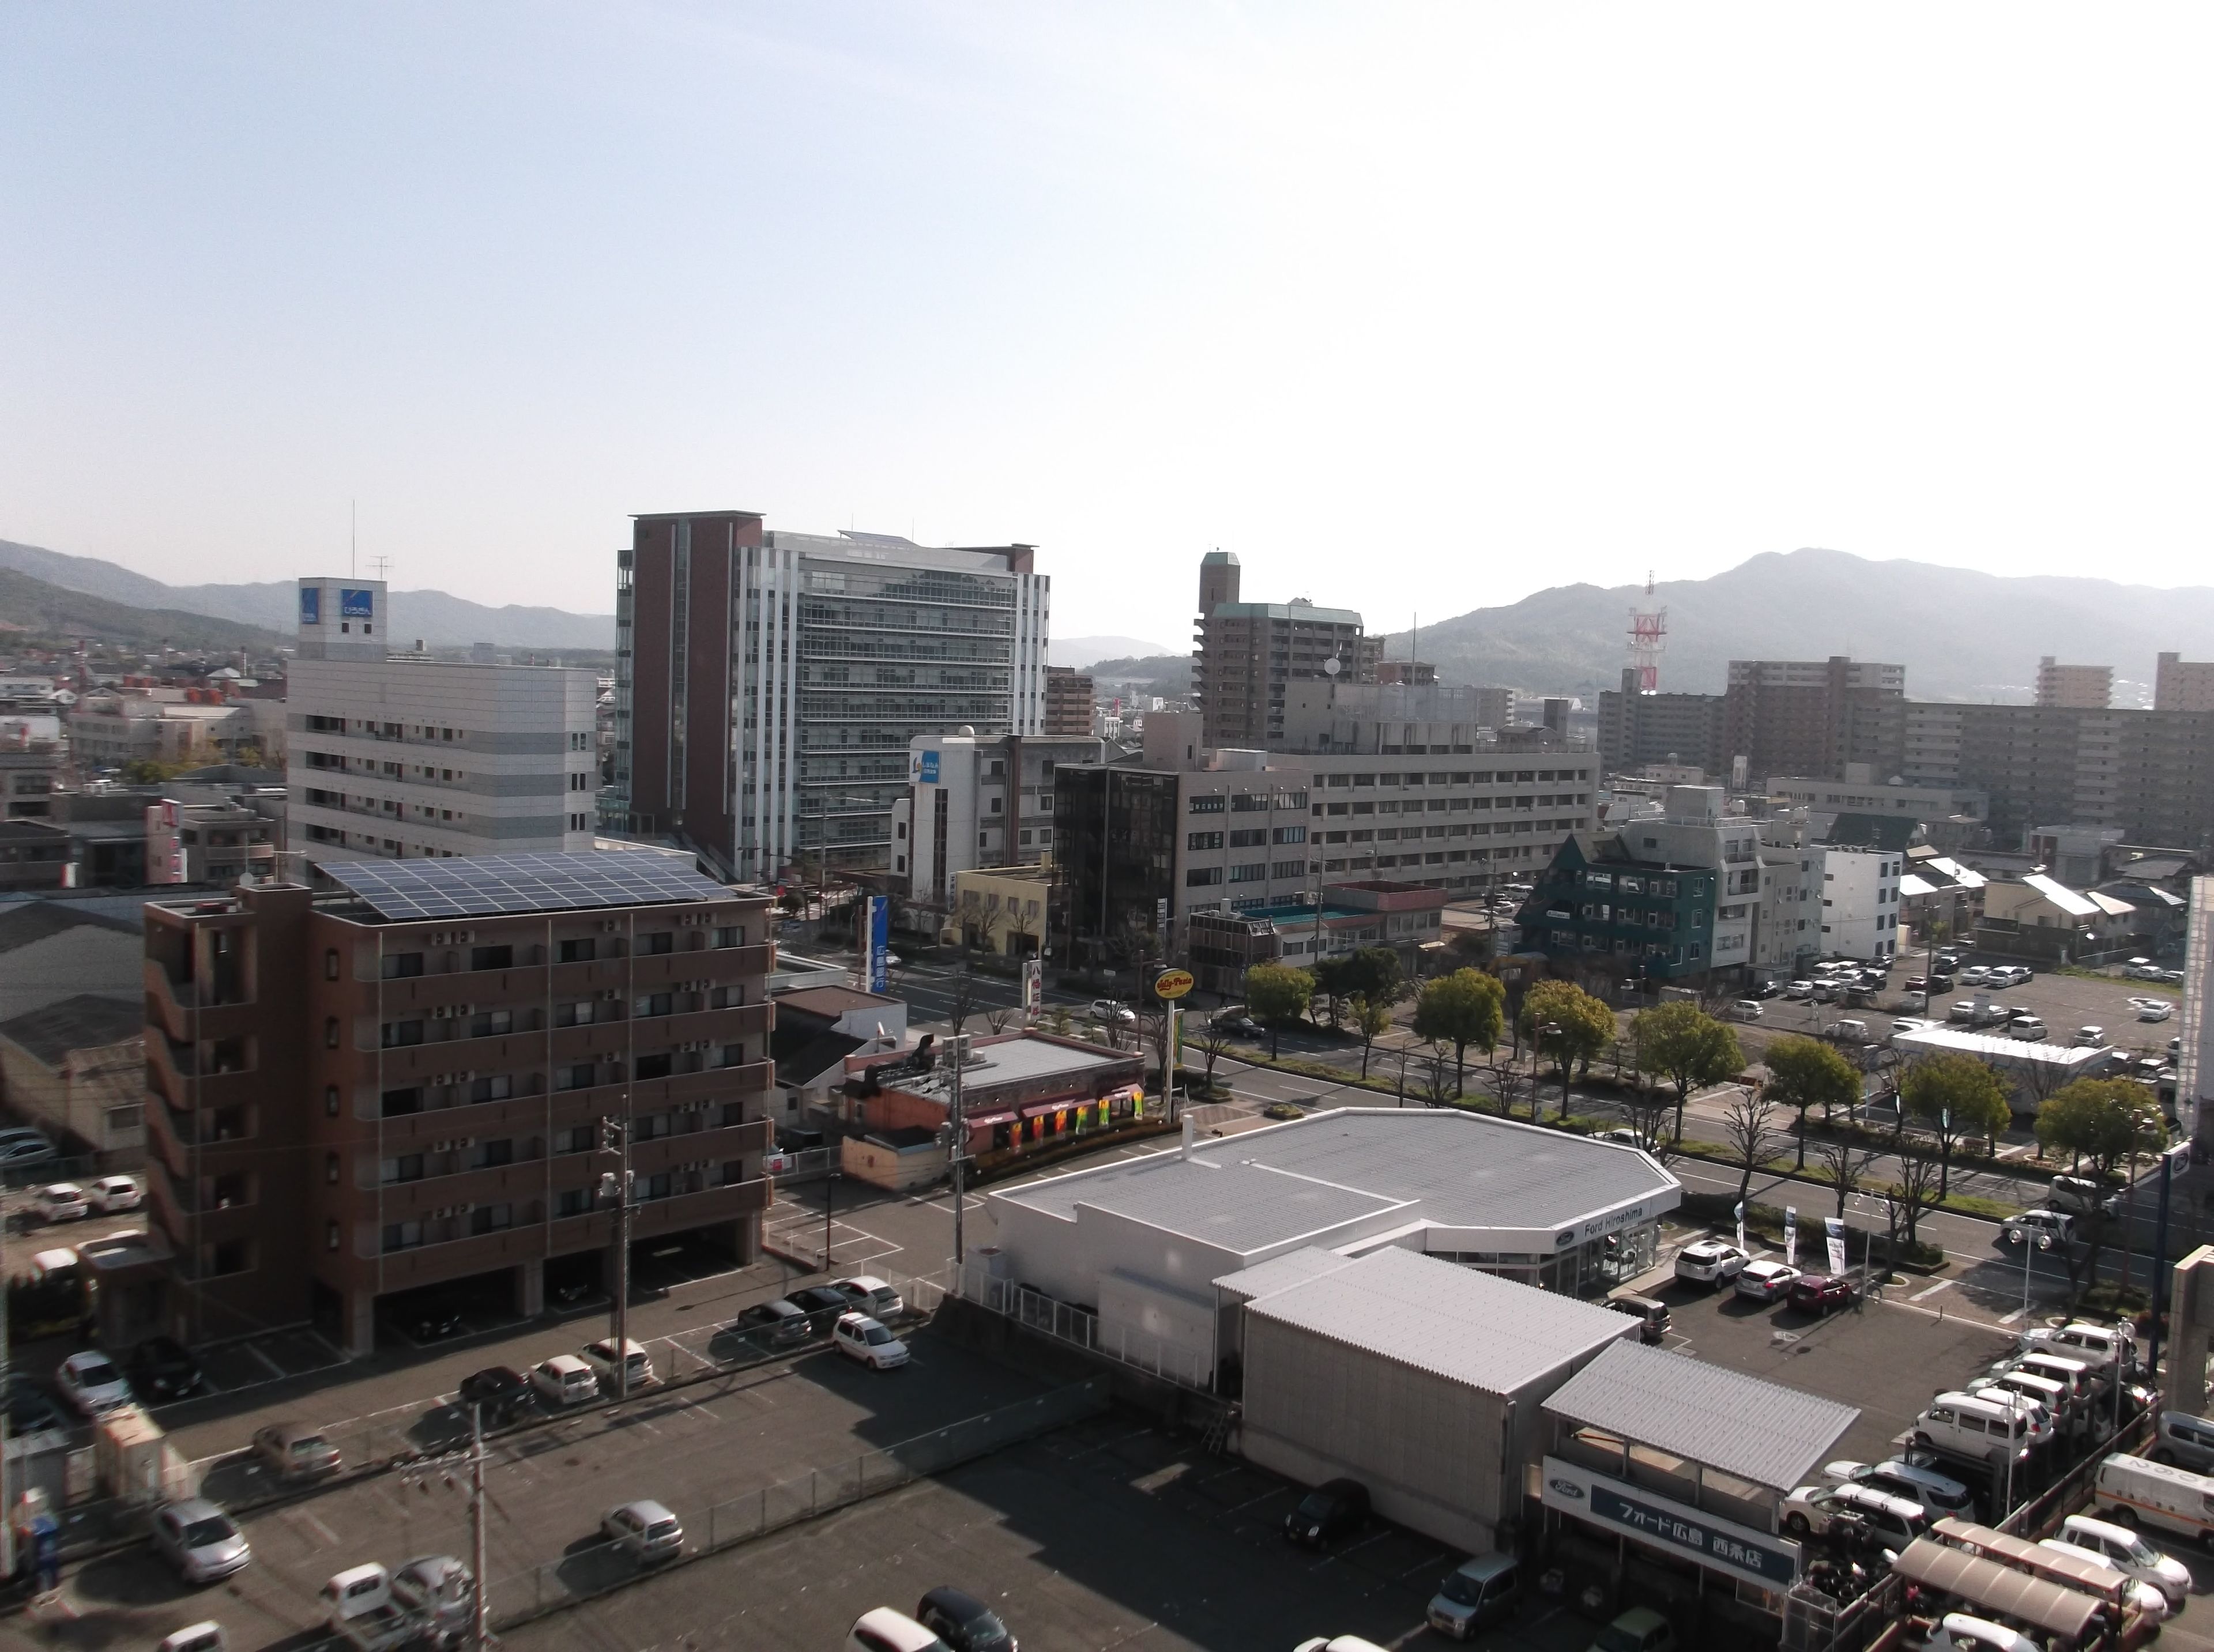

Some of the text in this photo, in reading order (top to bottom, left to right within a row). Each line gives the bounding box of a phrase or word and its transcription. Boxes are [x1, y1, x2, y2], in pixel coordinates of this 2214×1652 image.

[1585, 1207, 1643, 1236] Ford Hiroshima
[1554, 1479, 1579, 1497] Ford
[1619, 1502, 1762, 1568] フォード広島 西条店
